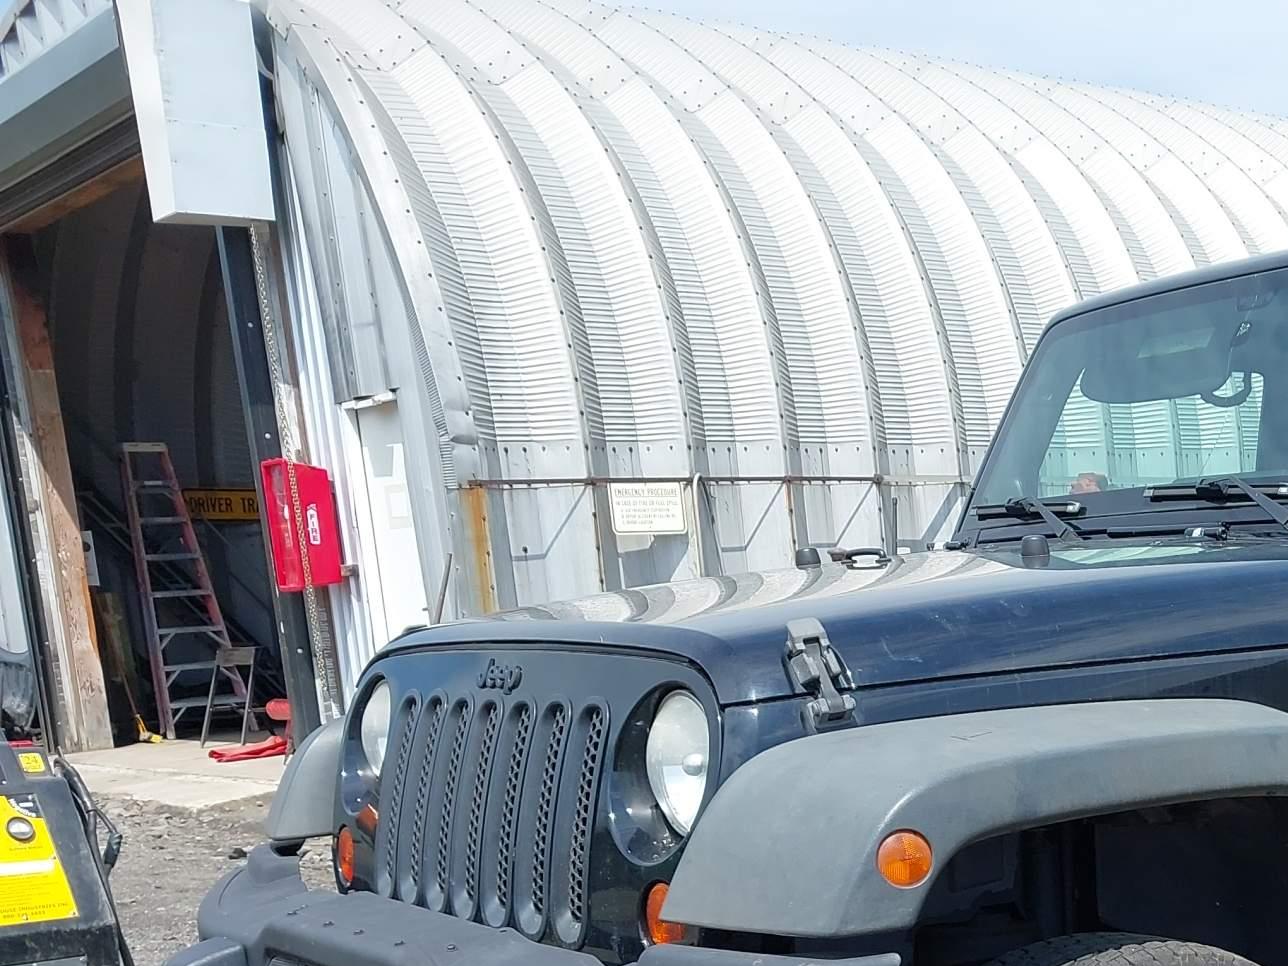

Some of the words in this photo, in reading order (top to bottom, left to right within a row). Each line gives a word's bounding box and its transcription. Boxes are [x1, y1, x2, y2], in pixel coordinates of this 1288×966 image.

[614, 488, 645, 496] EMERGENCY
[647, 488, 677, 496] PROCEDURE
[189, 496, 233, 513] DRIVER
[309, 513, 319, 542] FIRE
[476, 657, 523, 696] Jeep
